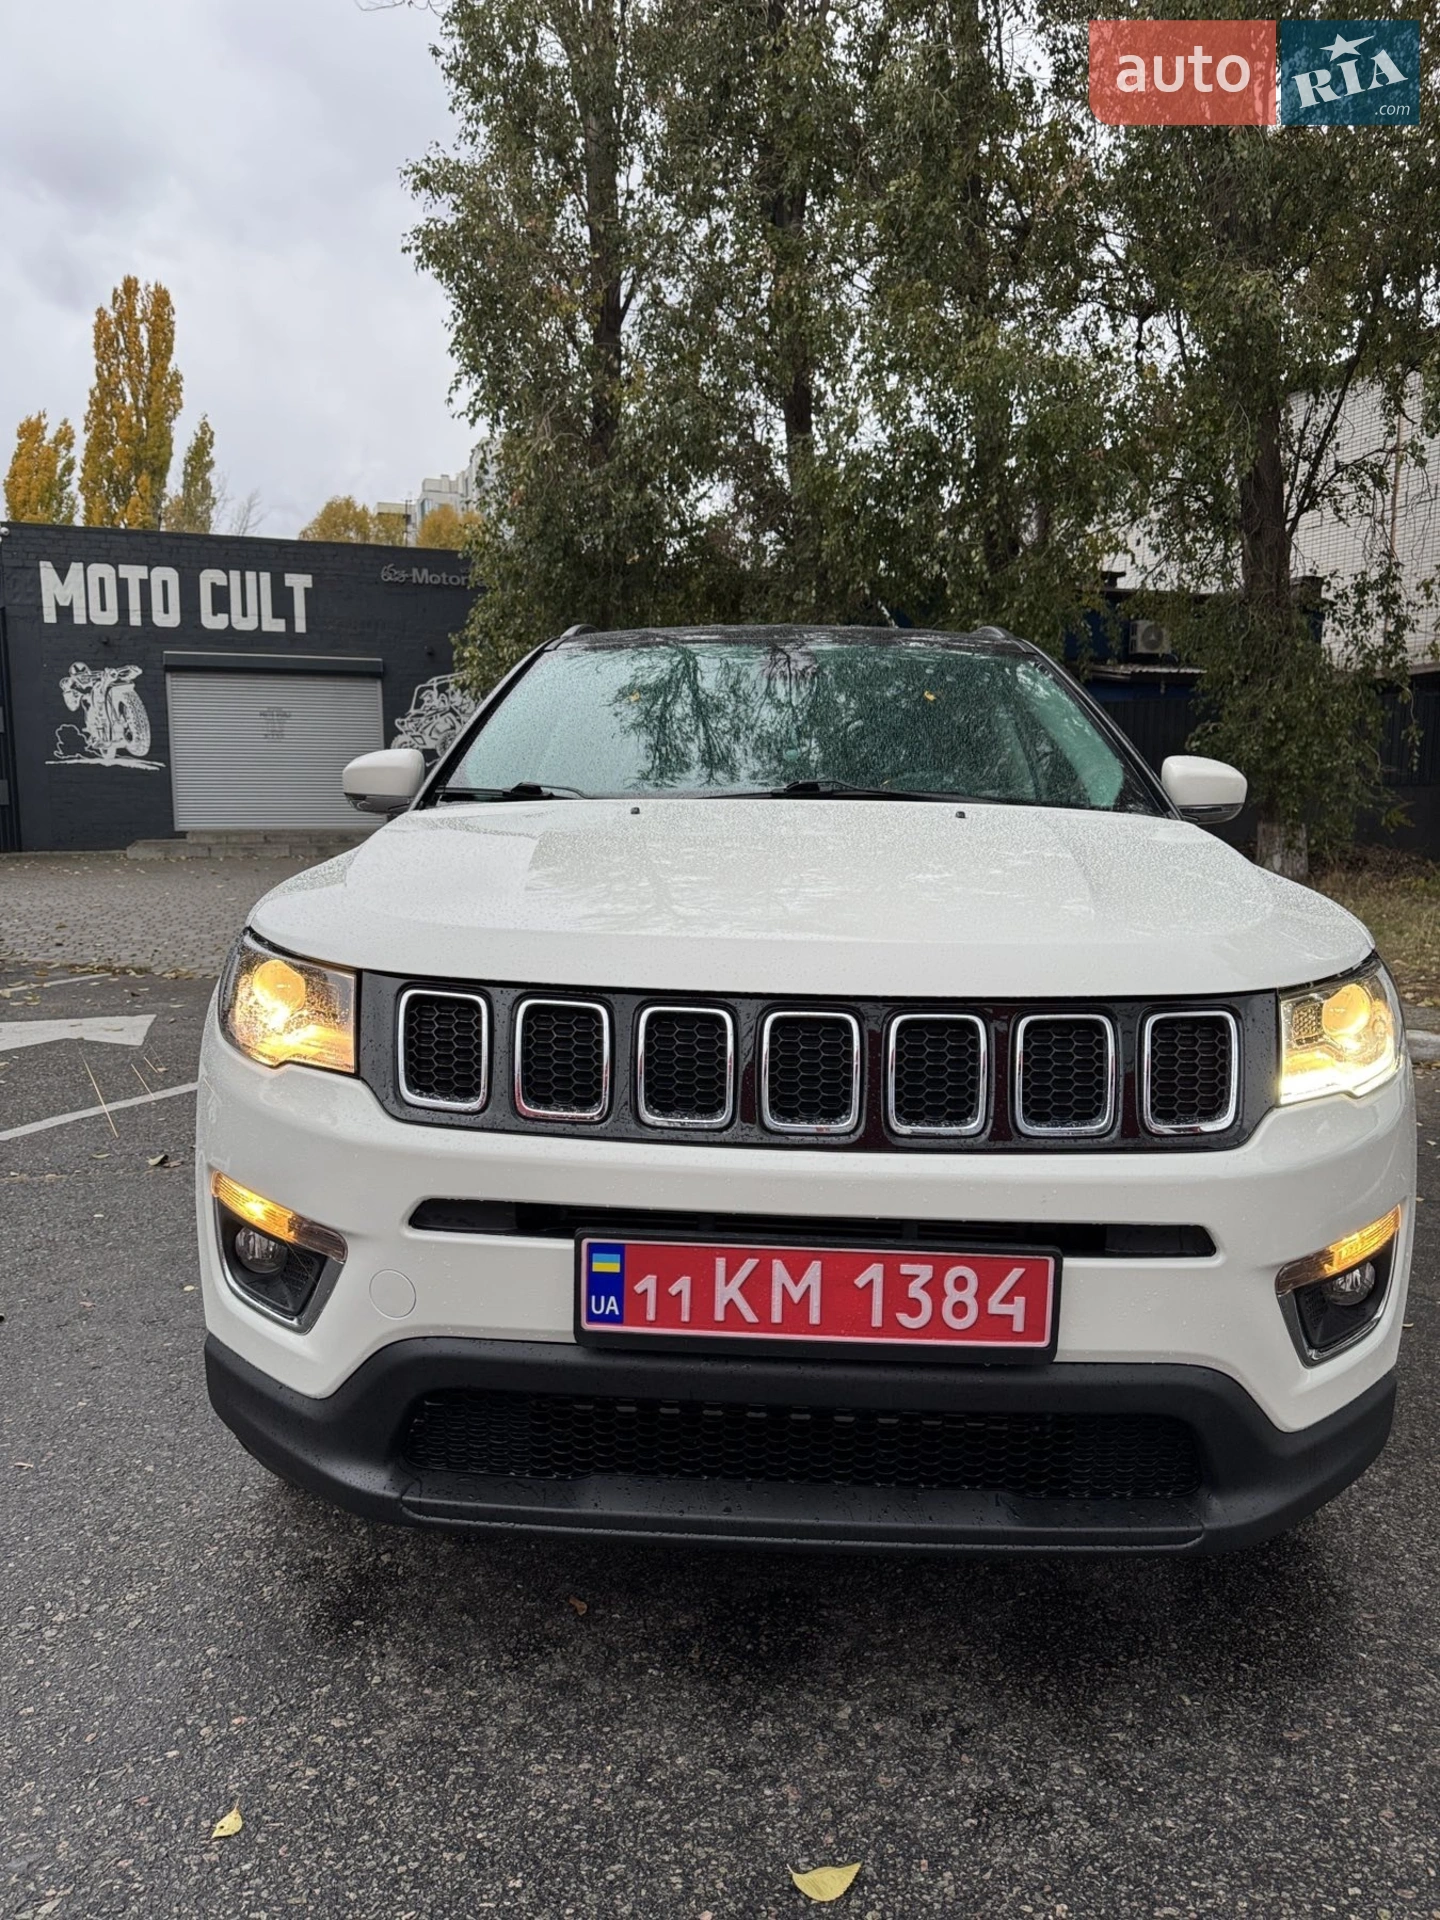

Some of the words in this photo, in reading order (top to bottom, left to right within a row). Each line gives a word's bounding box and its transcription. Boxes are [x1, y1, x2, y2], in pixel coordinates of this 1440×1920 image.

[39, 560, 181, 627] MOTO
[199, 569, 312, 633] CULT
[590, 1295, 620, 1317] UA
[633, 1274, 691, 1323] 11
[713, 1257, 822, 1326] KM
[853, 1263, 1026, 1333] 1384
